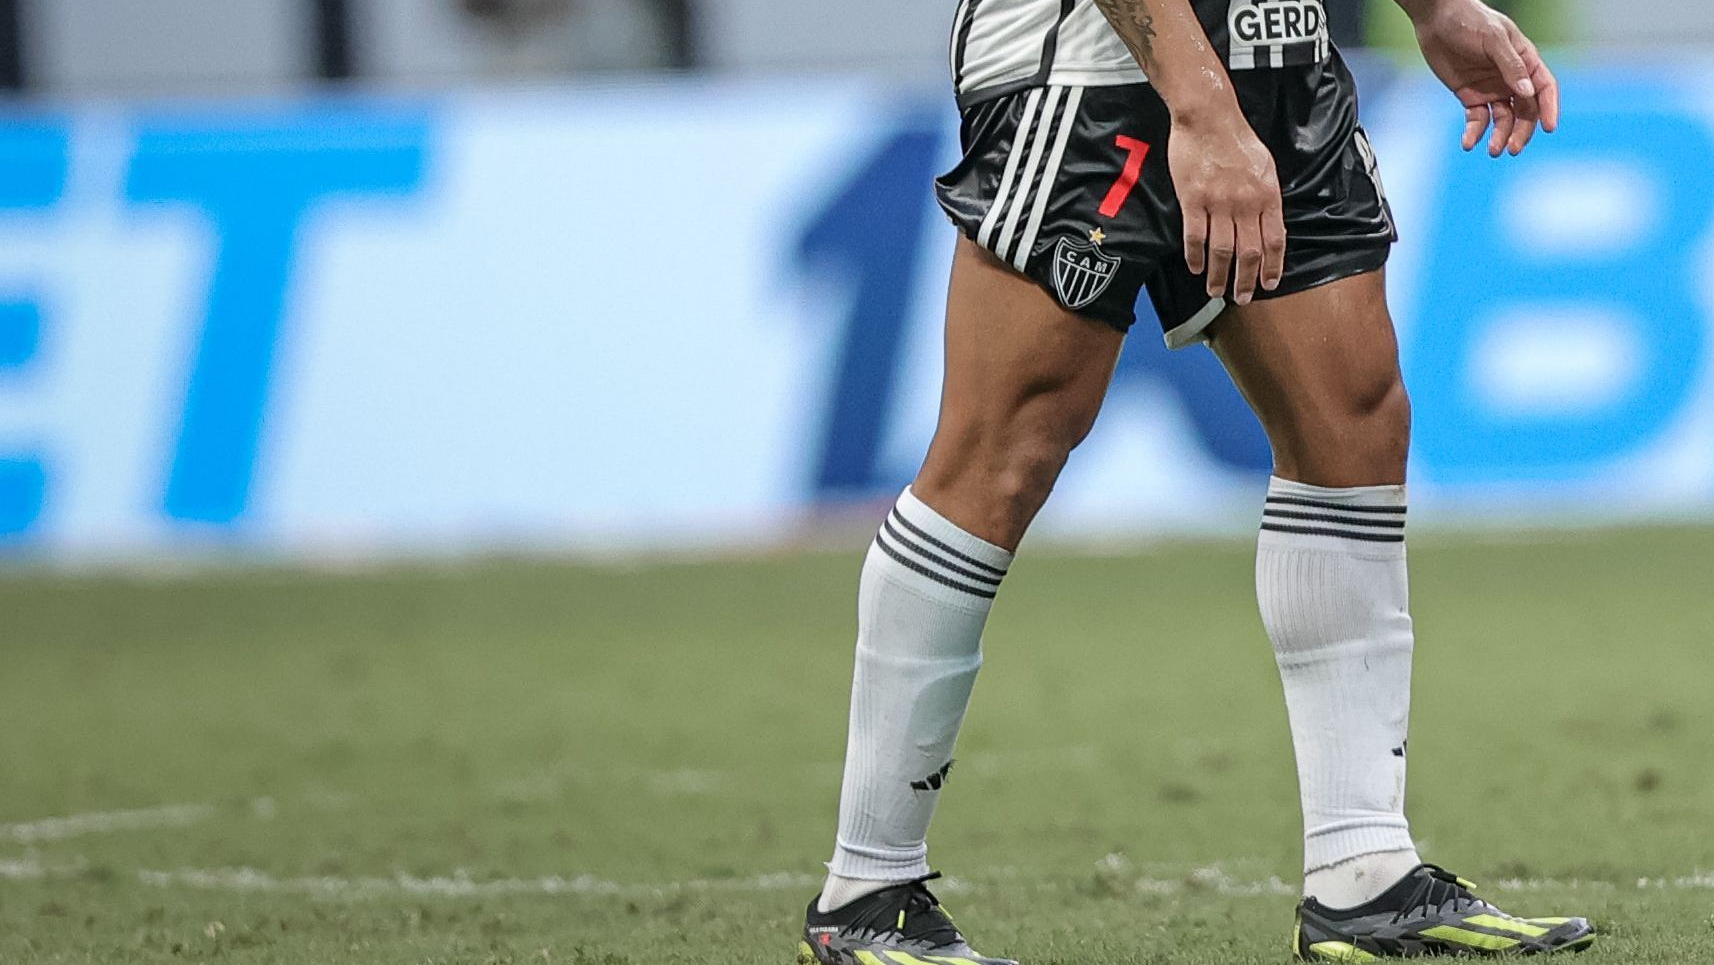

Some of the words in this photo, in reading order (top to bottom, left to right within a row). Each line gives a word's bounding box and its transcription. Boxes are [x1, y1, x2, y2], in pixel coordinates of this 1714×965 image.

[1235, 4, 1327, 42] GERD
[1098, 134, 1149, 218] 7
[1066, 250, 1108, 273] CAM
